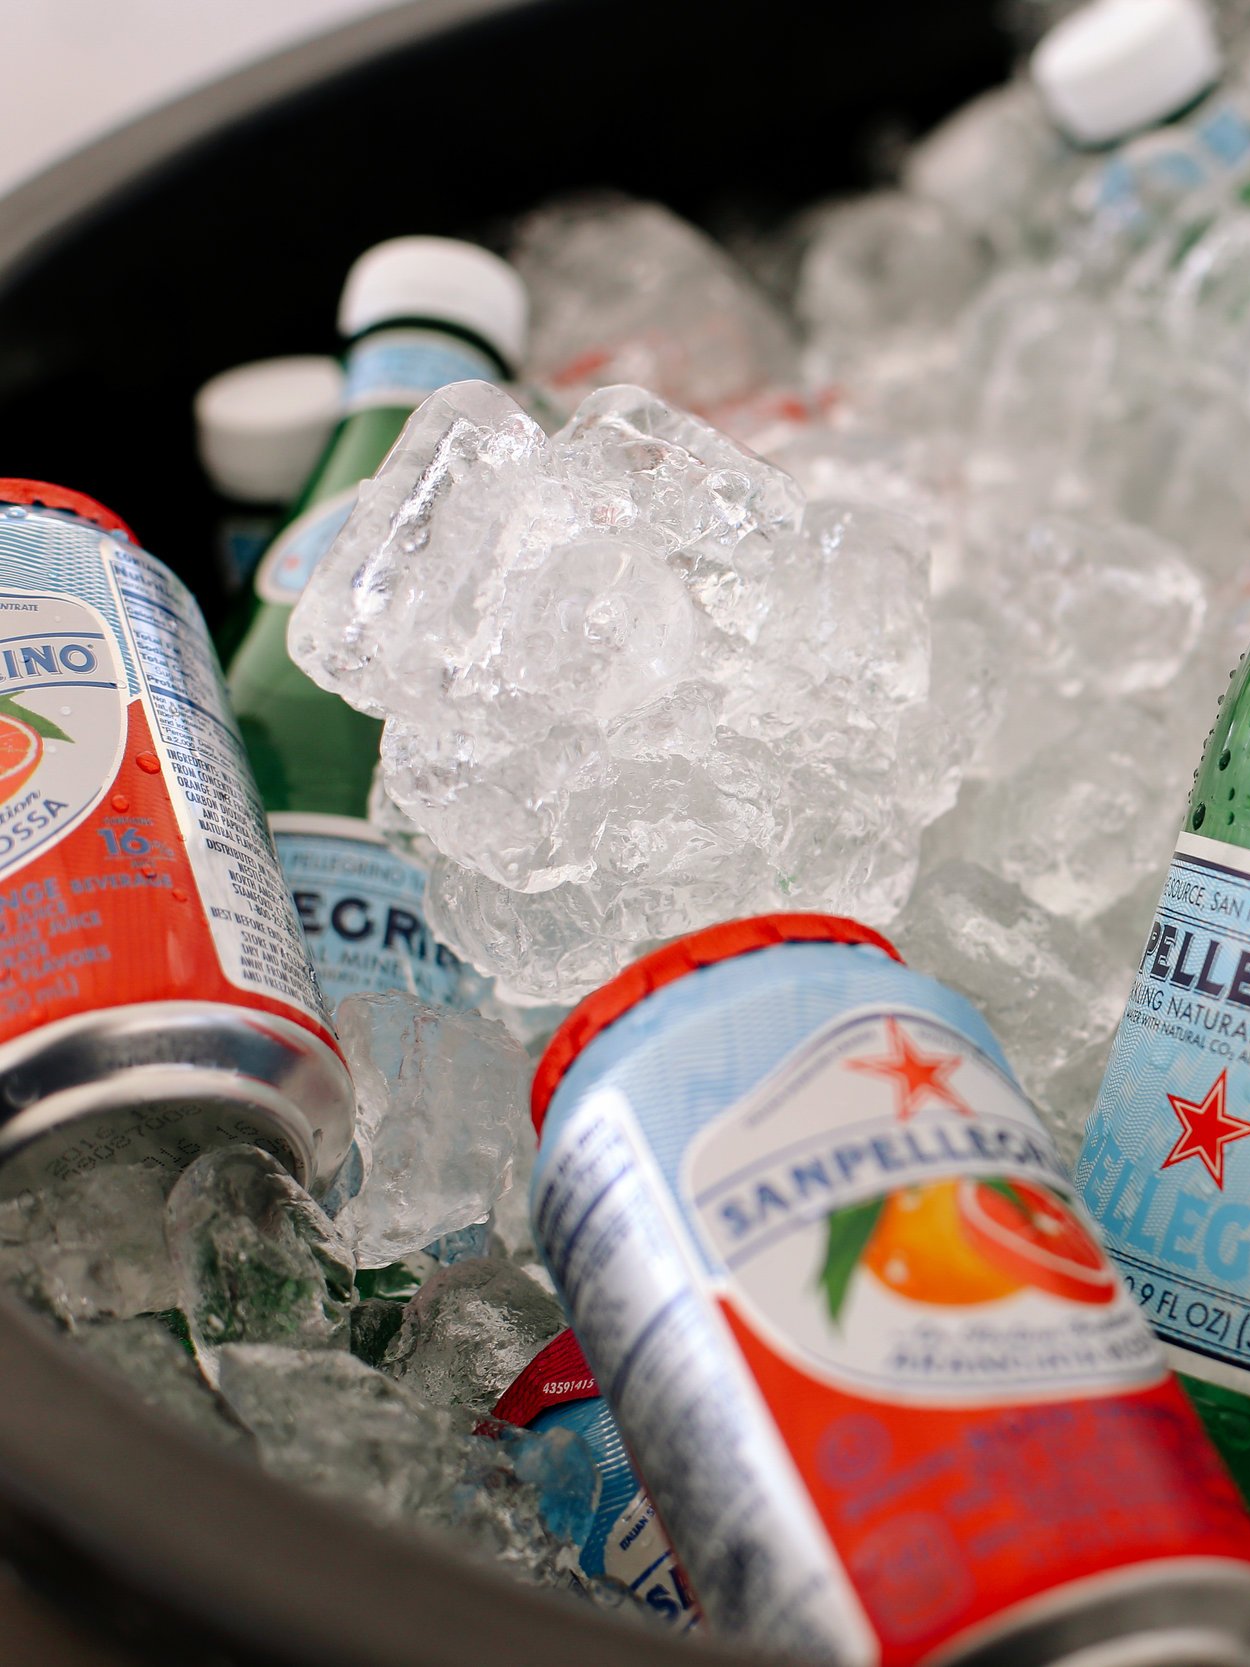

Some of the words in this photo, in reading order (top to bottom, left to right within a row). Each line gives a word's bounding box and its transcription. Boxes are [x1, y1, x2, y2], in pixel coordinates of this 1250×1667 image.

[1, 644, 98, 679] INO
[171, 763, 196, 778] FROM
[177, 776, 211, 796] ORANGE
[185, 791, 218, 811] CARBON
[203, 809, 219, 822] AND
[199, 819, 235, 841] NATURAL
[206, 838, 257, 869] DISTRIBUTED
[70, 873, 173, 894] BEVERAGE
[229, 869, 257, 893] NORTH
[1210, 892, 1245, 918] SAN
[210, 906, 233, 920] BEST
[234, 912, 267, 934] BEFORE
[241, 930, 267, 950] STORE
[241, 943, 260, 959] DRY
[1141, 1013, 1160, 1031] WITH
[1159, 1019, 1206, 1049] NATURAL
[1157, 1290, 1179, 1320] FL
[1186, 1302, 1232, 1342] OZ)
[542, 1378, 595, 1394] 43591415
[619, 1515, 649, 1551] ITALIAN
